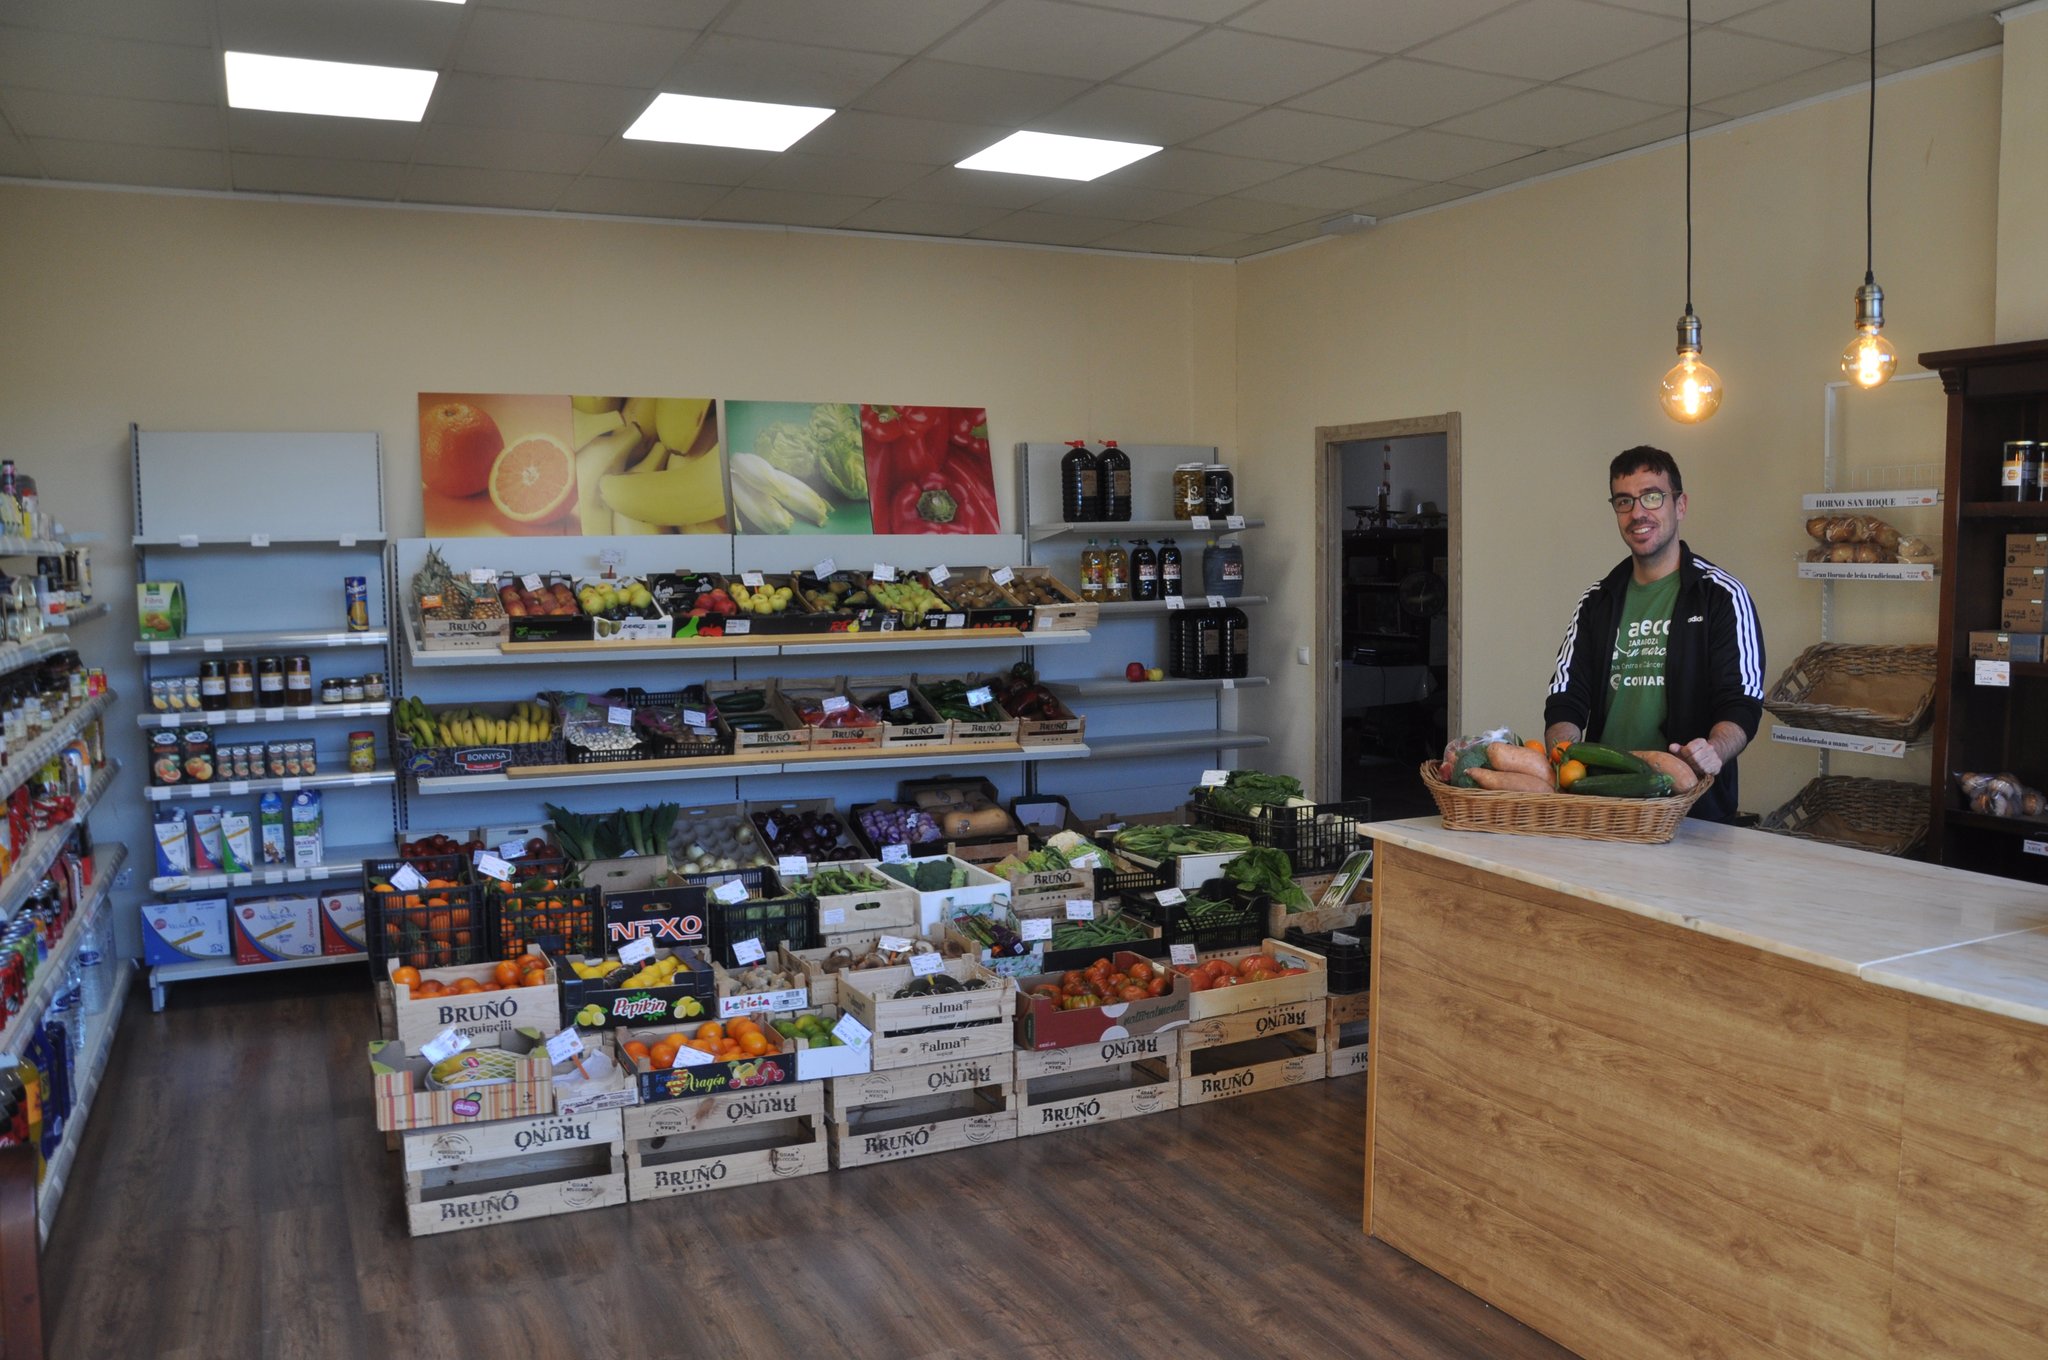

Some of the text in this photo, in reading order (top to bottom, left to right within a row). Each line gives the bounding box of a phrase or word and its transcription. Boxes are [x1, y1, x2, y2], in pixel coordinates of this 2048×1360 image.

[1815, 498, 1896, 508] HORNO SAN ROQUE
[1641, 646, 1667, 656] marc
[1623, 675, 1665, 687] COVIAR
[1799, 737, 1827, 745] elaborado
[467, 752, 507, 762] BONNYSA
[1033, 870, 1072, 884] BRUÑÓ
[608, 915, 702, 941] NEXO
[438, 996, 518, 1025] BRUÑÓ
[612, 997, 667, 1020] Pepikin
[1256, 1010, 1307, 1035] BRUÑÓ
[1101, 1036, 1158, 1063] BRUÑÓ
[686, 1072, 726, 1093] Aragón
[928, 1065, 992, 1091] BRUÑÓ
[1201, 1069, 1254, 1095] BRUÑÓ
[455, 1103, 477, 1114] plump
[726, 1095, 797, 1123] BRUÑÓ
[1042, 1098, 1100, 1124] BRUÑÓ
[515, 1121, 591, 1151] BRUÑÓ
[864, 1126, 929, 1154] BRUÑÓ
[654, 1159, 727, 1189] BRUÑÓ
[440, 1192, 519, 1221] BRUÑÓ
